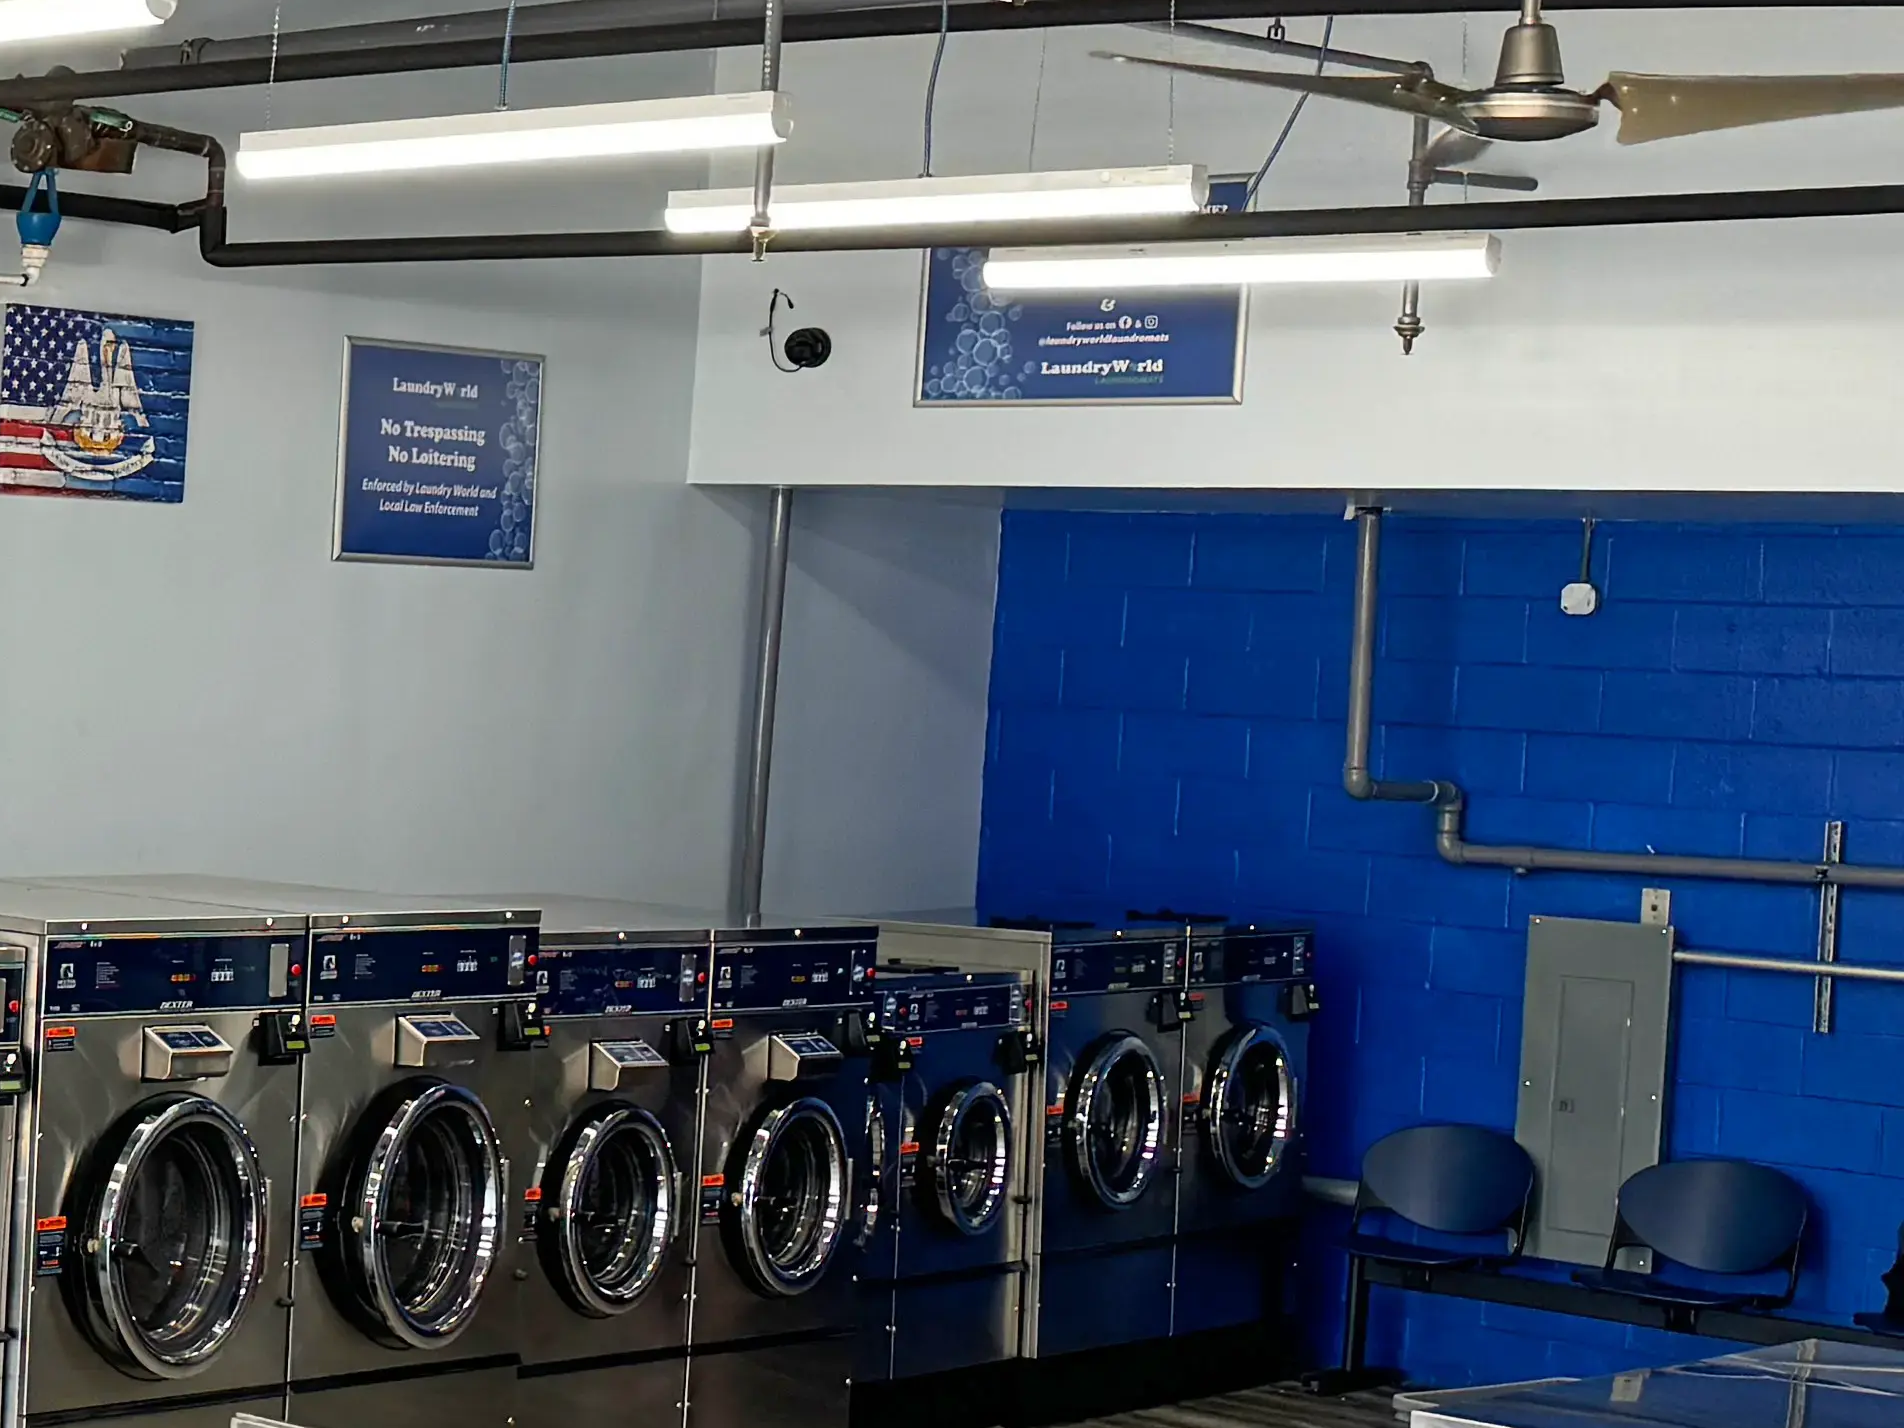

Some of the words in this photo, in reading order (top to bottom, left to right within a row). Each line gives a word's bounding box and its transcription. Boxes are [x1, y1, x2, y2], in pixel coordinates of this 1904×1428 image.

[1101, 299, 1116, 311] &
[381, 418, 400, 435] No
[404, 421, 486, 446] Trespassing
[389, 446, 408, 463] No
[412, 447, 476, 472] Loitering
[362, 478, 402, 493] Enforced
[404, 480, 414, 495] by
[416, 482, 452, 498] Laundry
[453, 485, 479, 498] World
[480, 487, 497, 499] and
[380, 499, 403, 511] Local
[405, 500, 423, 513] Law
[424, 502, 479, 516] Enforcement
